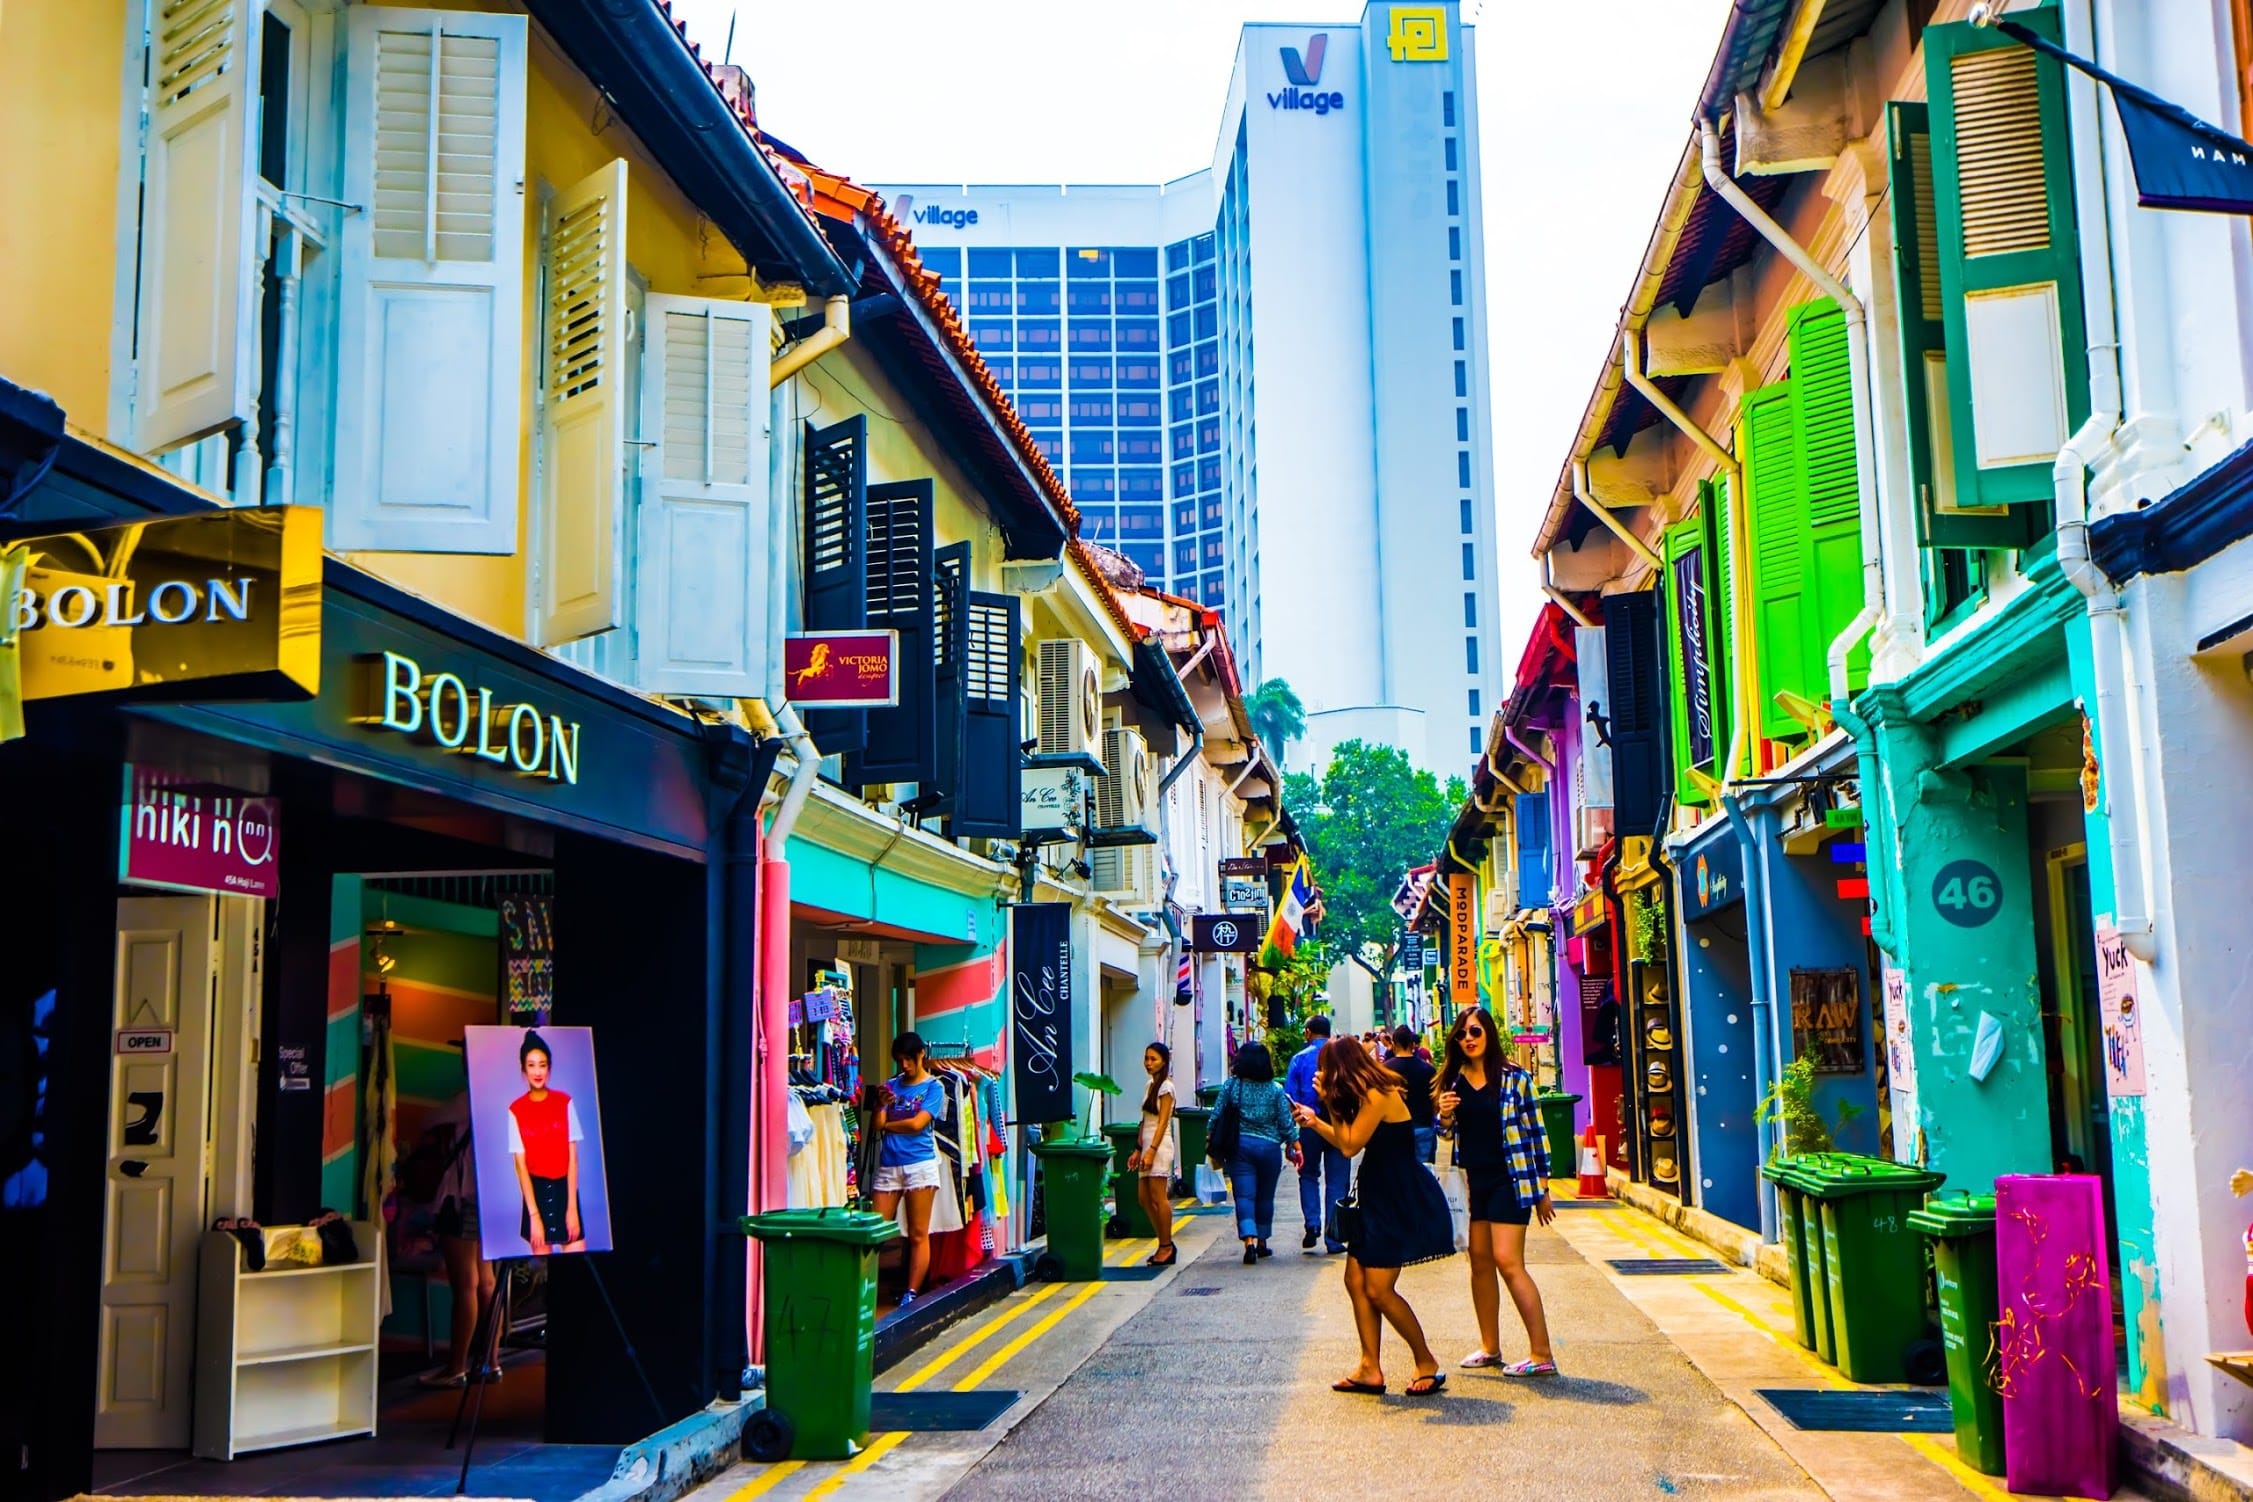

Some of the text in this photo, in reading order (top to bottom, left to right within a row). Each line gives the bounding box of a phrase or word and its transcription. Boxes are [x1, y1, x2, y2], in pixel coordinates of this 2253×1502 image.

[1267, 87, 1344, 115] village
[913, 205, 978, 229] village
[8, 578, 256, 633] BOLON
[838, 655, 888, 665] VICTORIA
[858, 663, 888, 674] JOMO
[1684, 580, 1713, 740] Simplicity
[382, 650, 581, 785] BOLON
[1938, 876, 1996, 910] 46
[1456, 887, 1469, 990] MODPARADE
[1059, 940, 1069, 1001] CHANTELLE
[1791, 1002, 1859, 1030] RAW
[127, 1036, 162, 1049] OPEN
[278, 1046, 306, 1060] Special
[1017, 1020, 1060, 1092] An
[1872, 1215, 1899, 1233] 48
